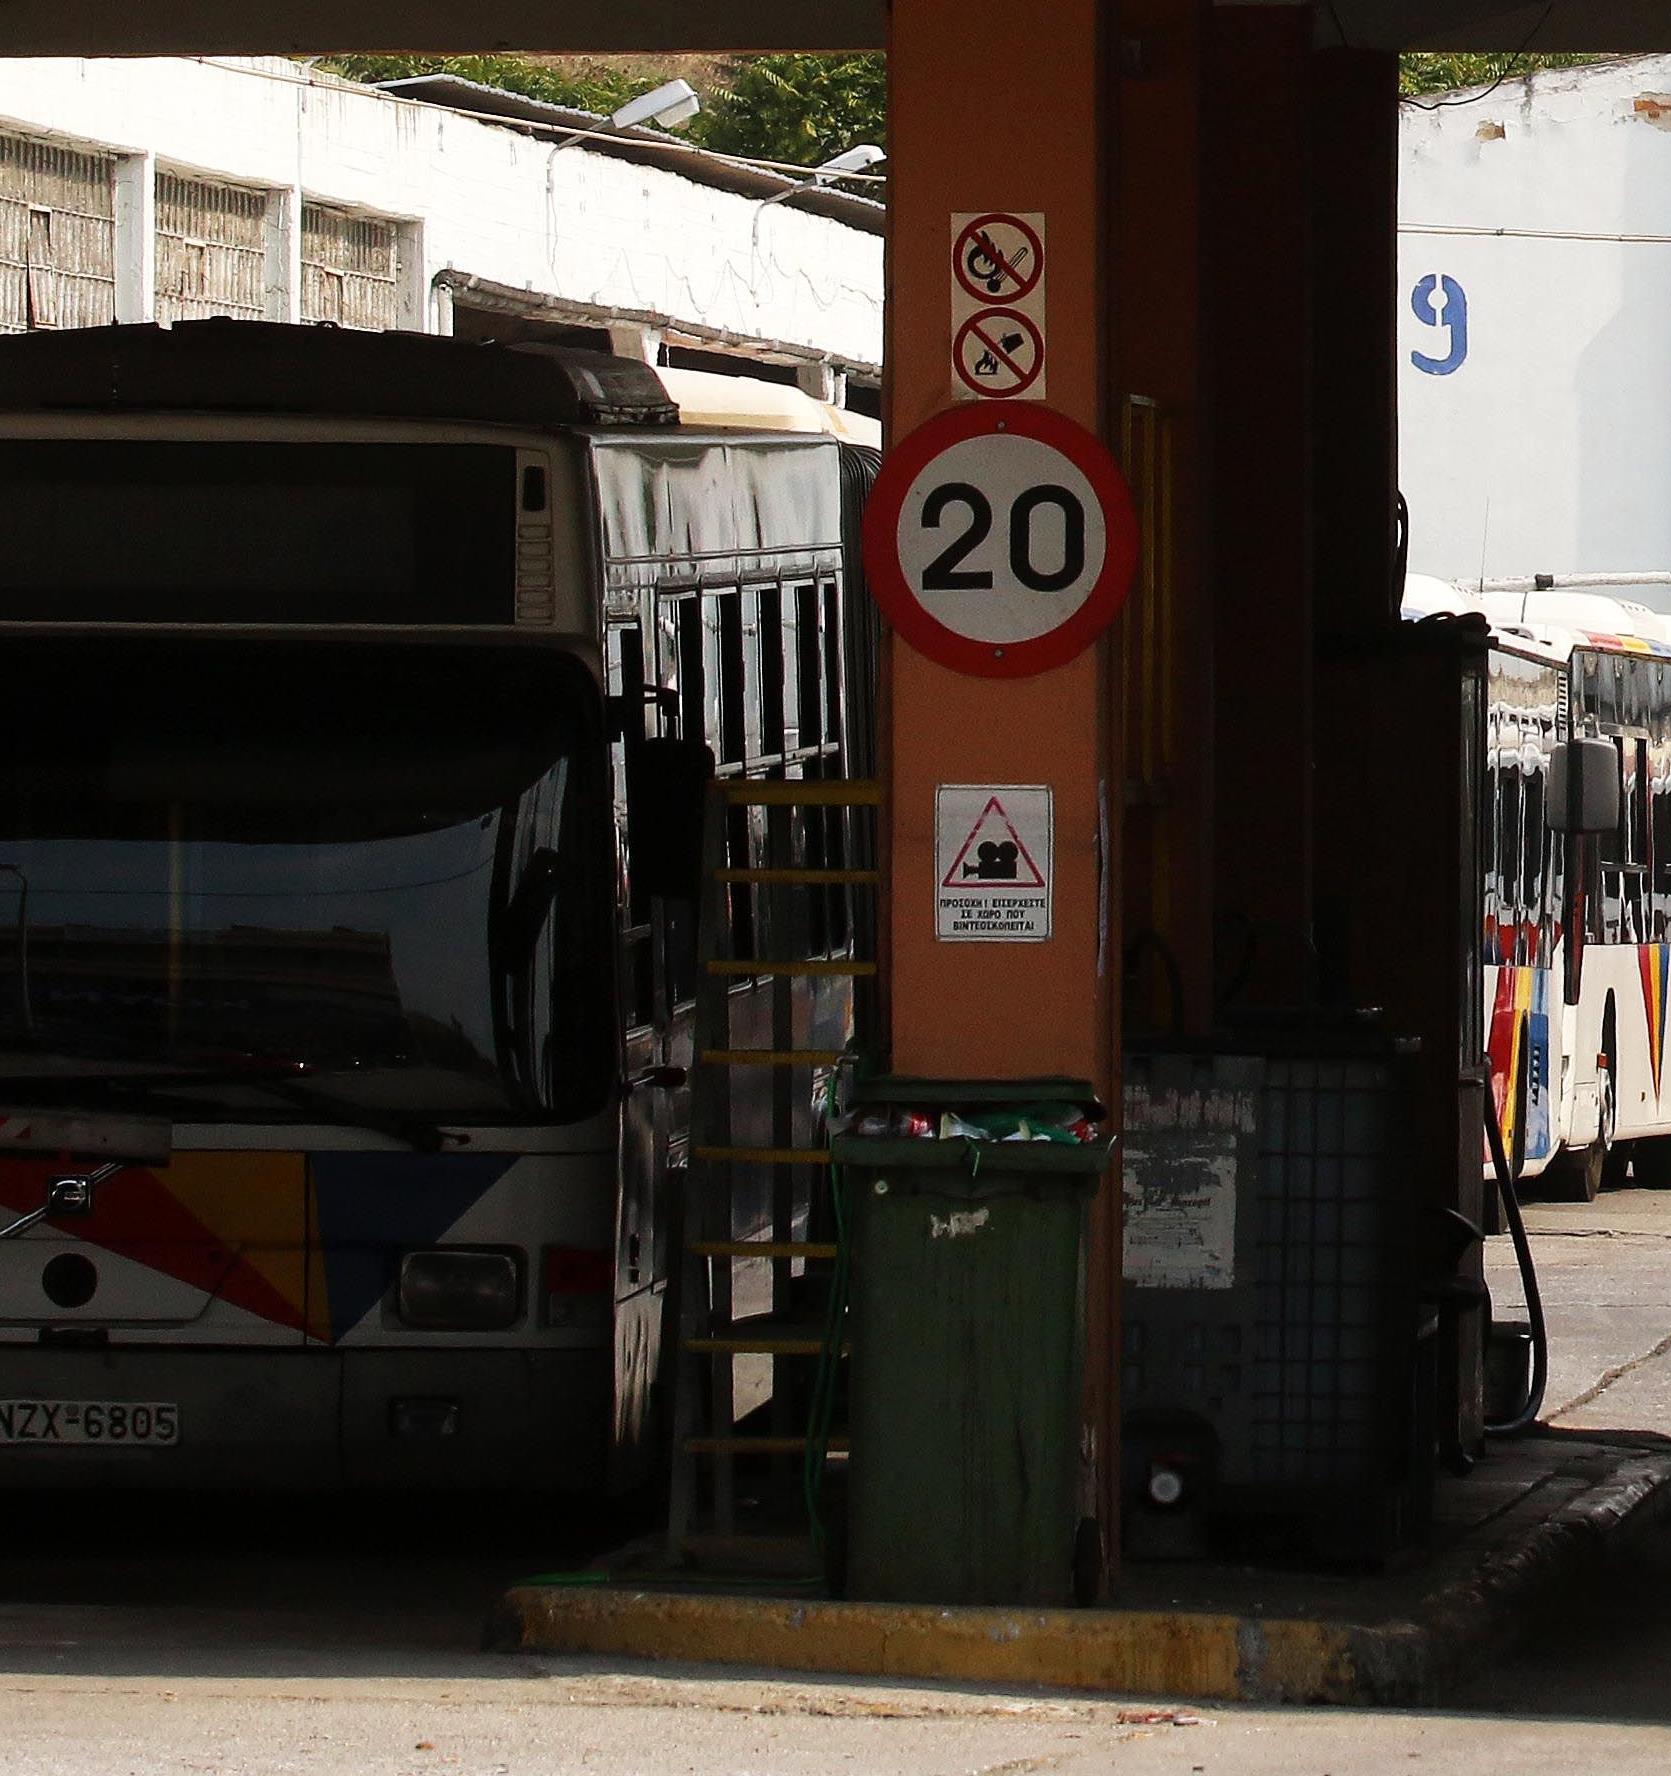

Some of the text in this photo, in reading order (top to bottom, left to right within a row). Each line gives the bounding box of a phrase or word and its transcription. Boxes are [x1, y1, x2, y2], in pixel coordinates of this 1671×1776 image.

[1410, 273, 1468, 376] 9
[920, 482, 1085, 593] 20
[1006, 910, 1026, 919] ΠΟΥ
